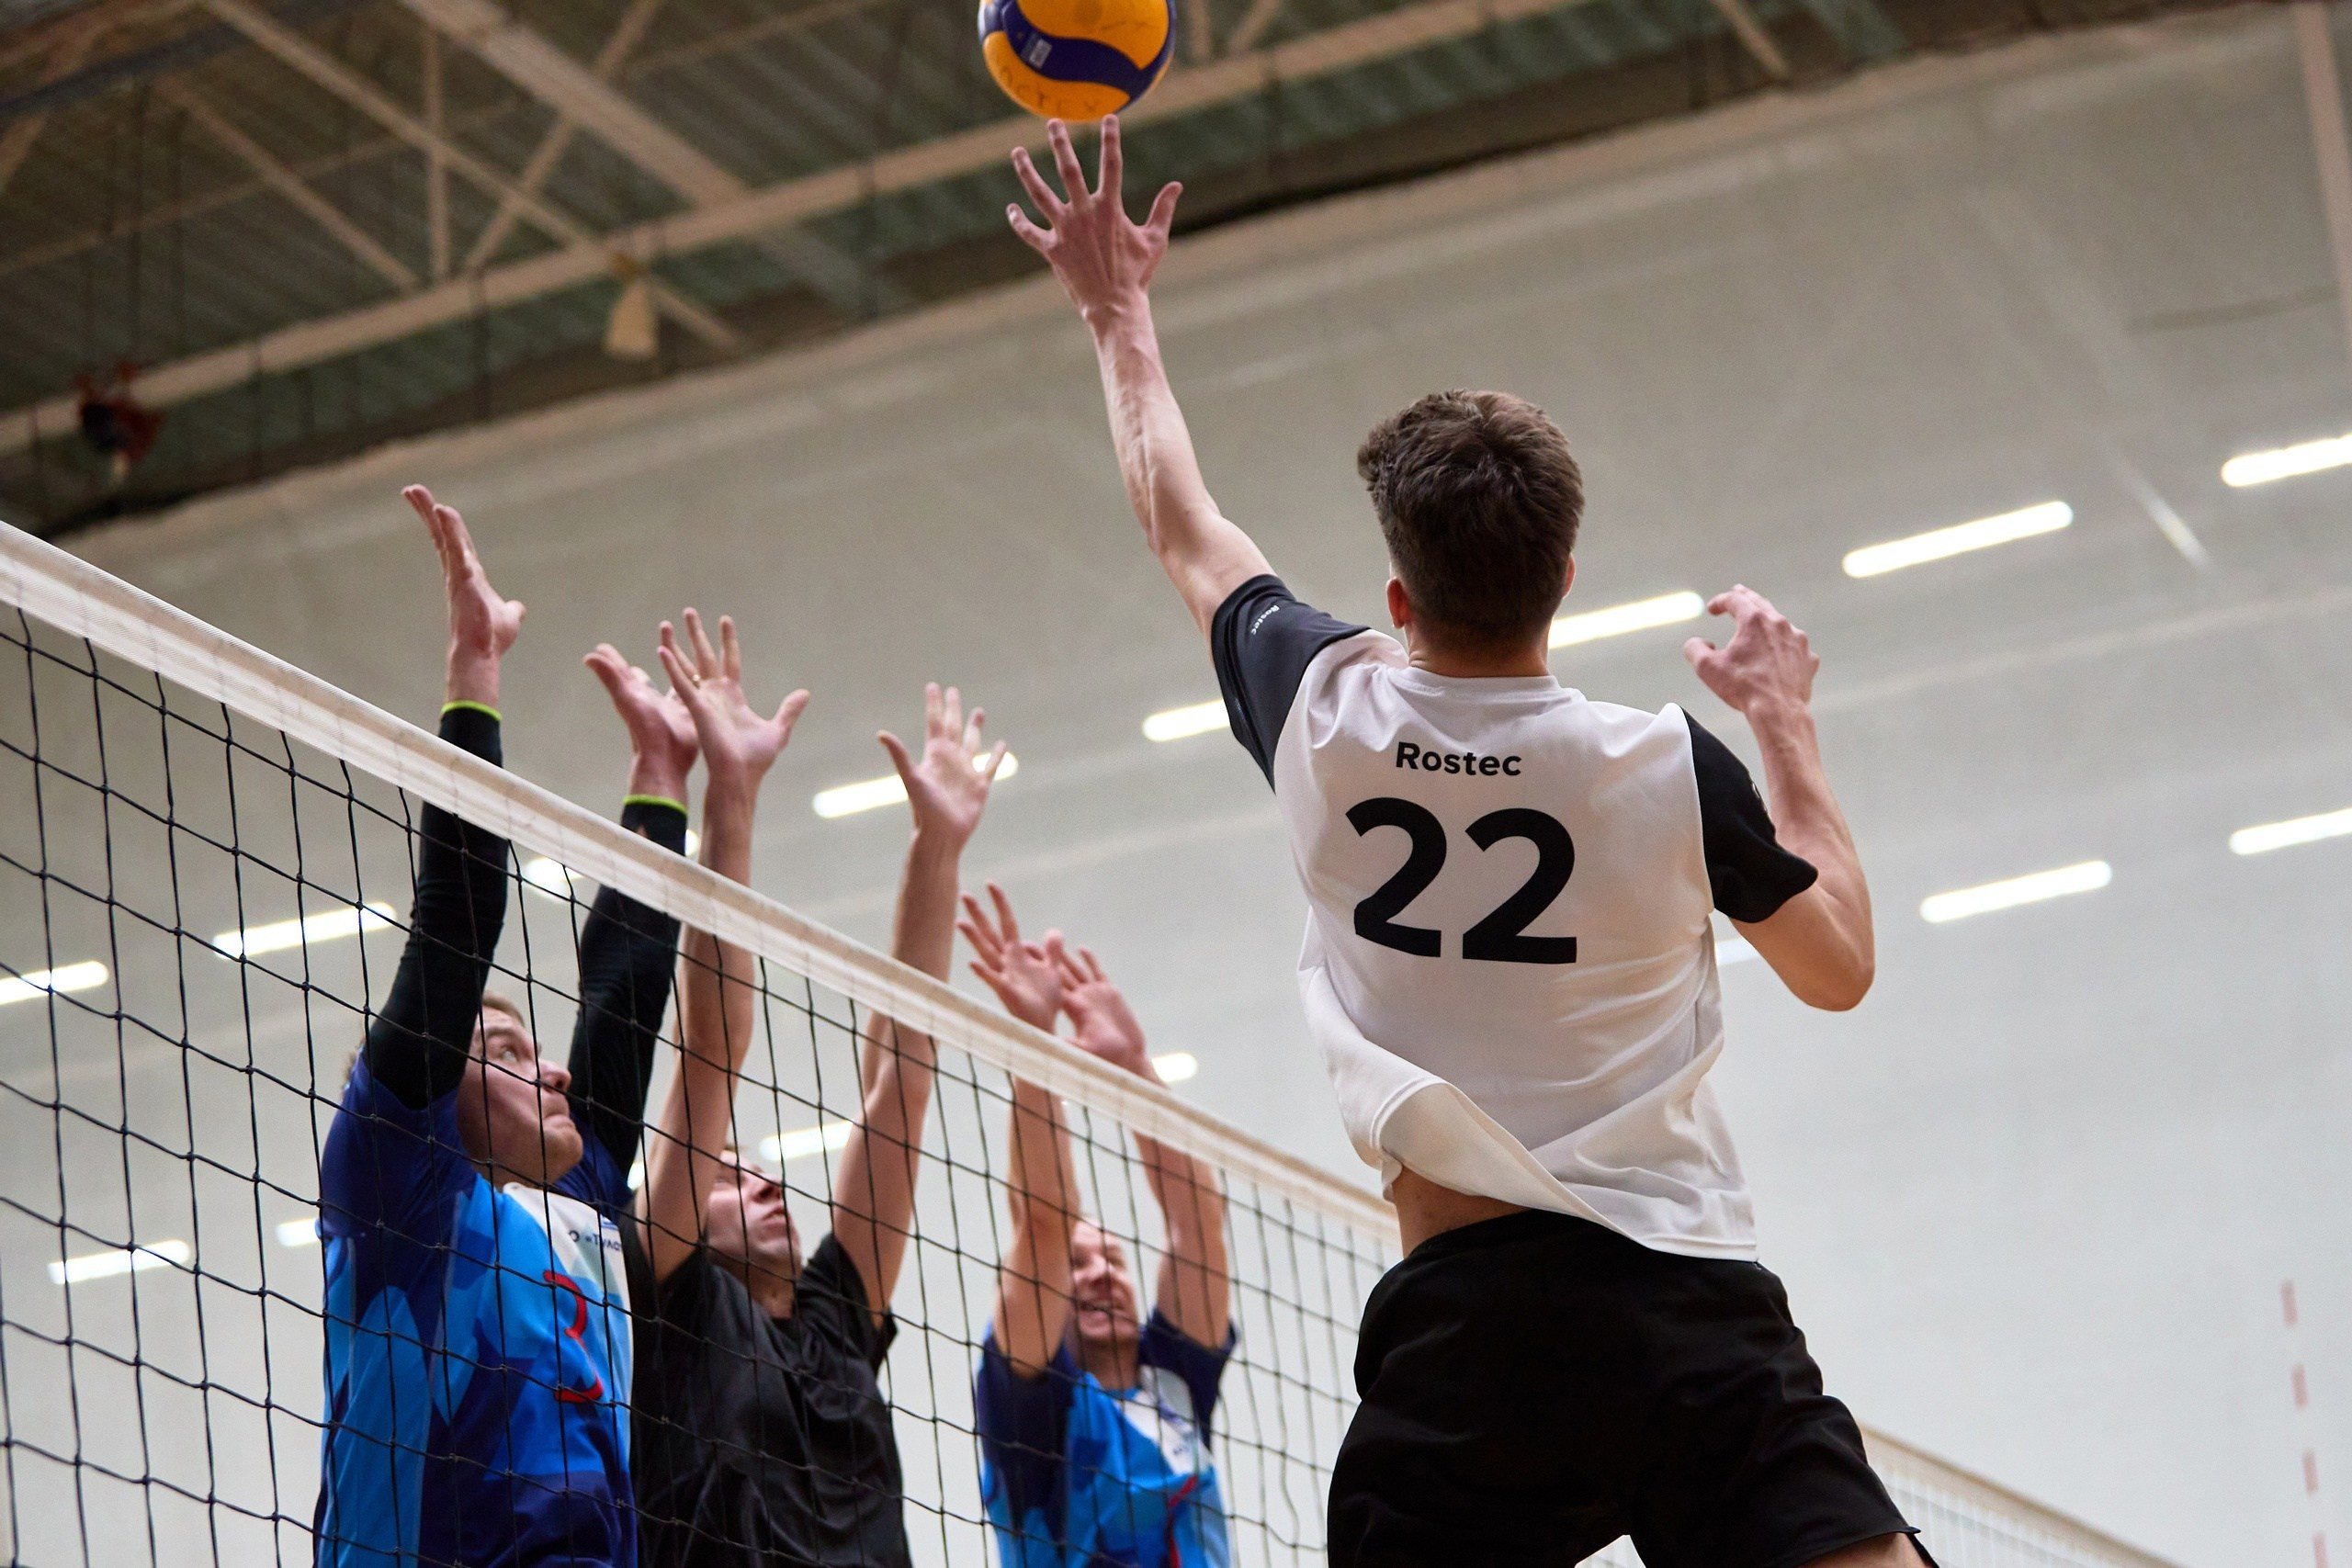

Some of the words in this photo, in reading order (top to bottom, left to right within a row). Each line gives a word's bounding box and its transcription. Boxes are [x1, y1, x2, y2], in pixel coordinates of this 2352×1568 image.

[1250, 604, 1280, 636] Rostec
[1396, 741, 1521, 776] Rostec
[1345, 796, 1577, 964] 22
